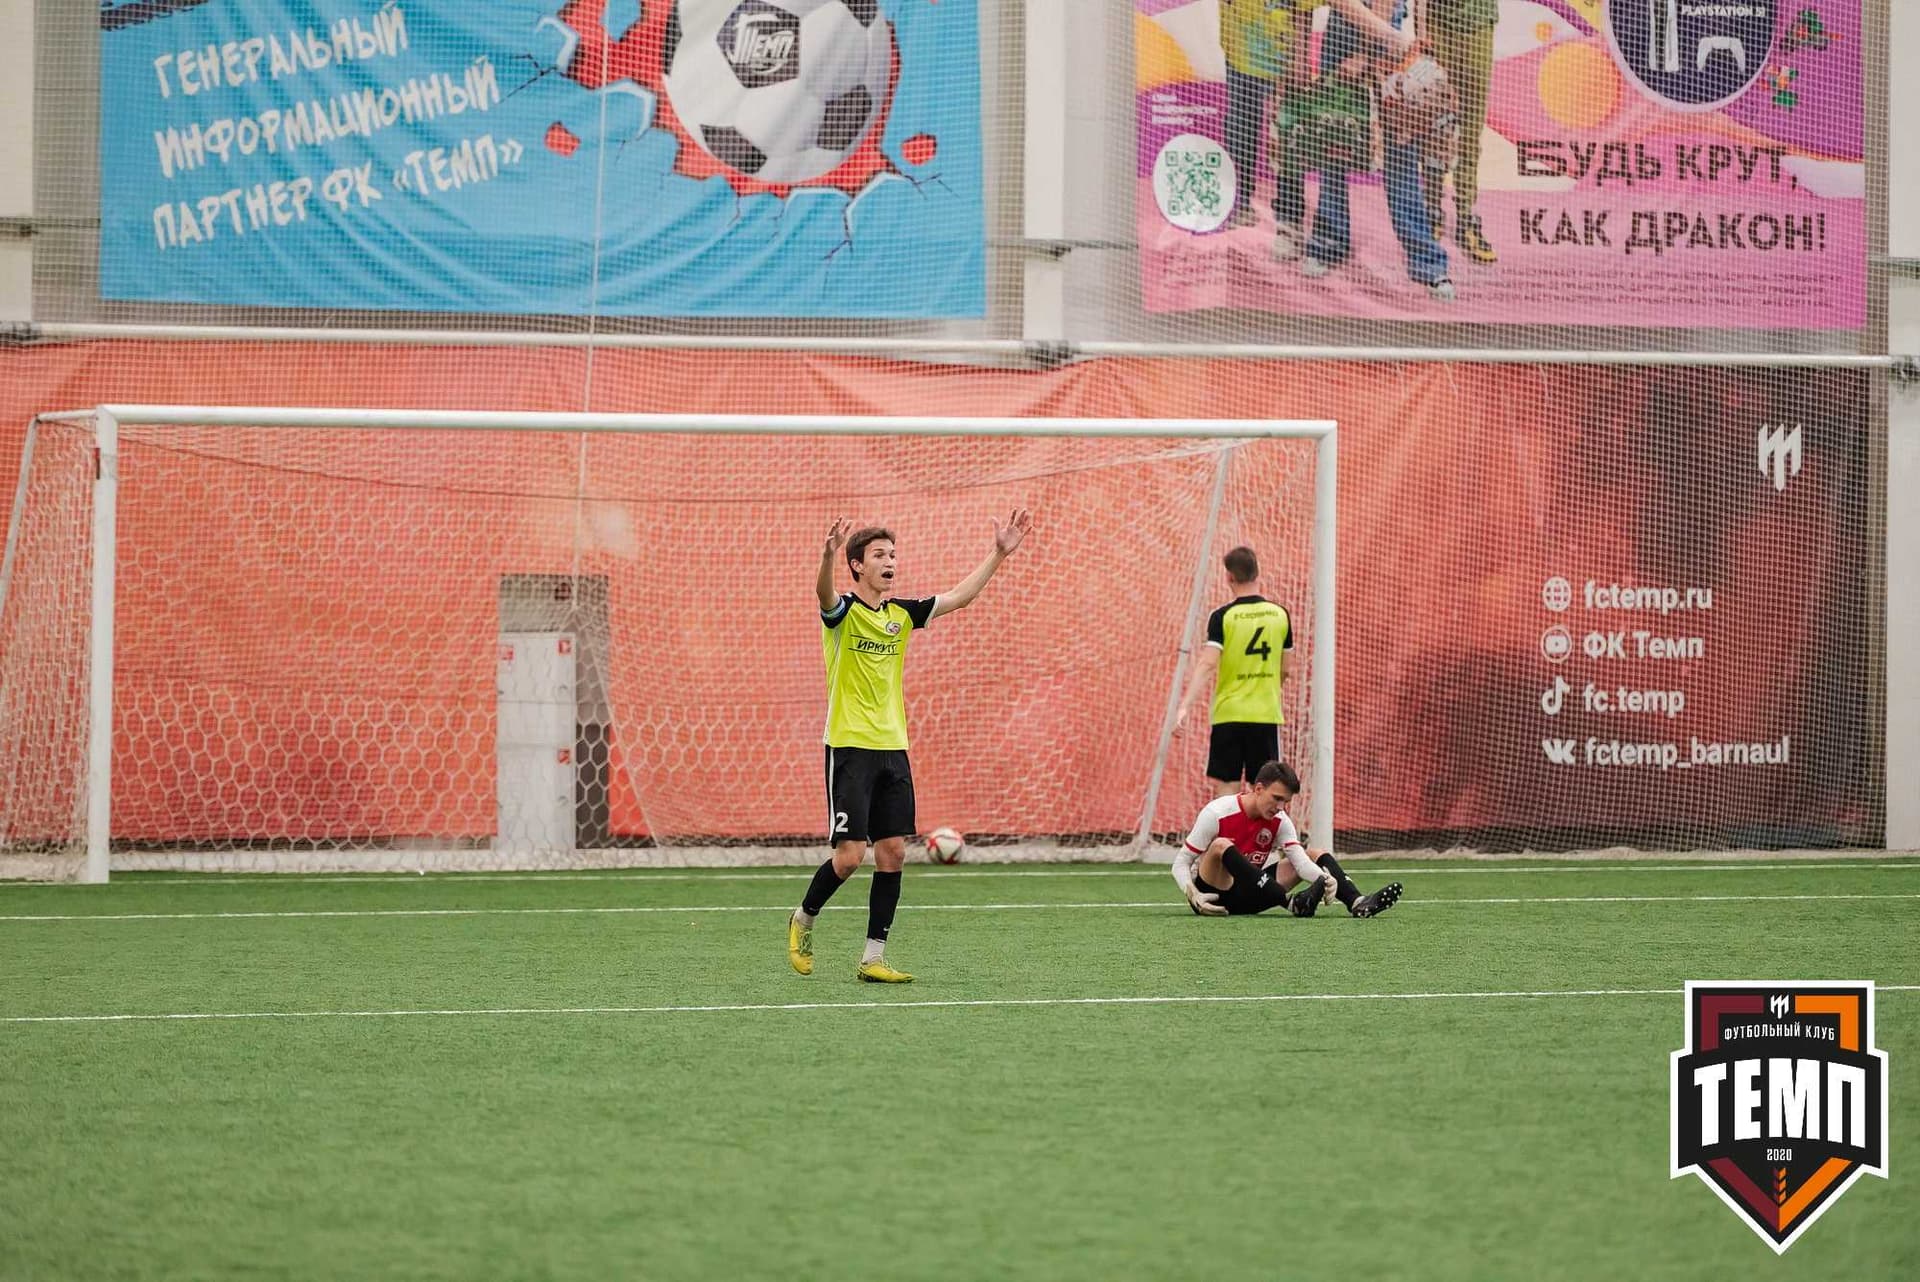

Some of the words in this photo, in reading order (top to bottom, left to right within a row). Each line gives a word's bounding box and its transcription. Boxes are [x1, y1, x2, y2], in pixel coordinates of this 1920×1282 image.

[1681, 4, 1752, 17] PLAYSTATION
[154, 2, 408, 98] ГЕНЕРАЛЬНЫЙ
[155, 56, 500, 179] ИНФОРМАЦИОННЫЙ
[1516, 140, 1661, 187] БУДЬ
[1676, 143, 1798, 190] КРУТ,
[154, 176, 312, 250] ПАРТНЕР
[321, 159, 382, 212] ФК
[393, 133, 524, 195] «ТЕМП»
[1519, 207, 1612, 248] КАК
[1624, 211, 1826, 256] ДРАКОН!
[1584, 579, 1713, 616] fctemp.ru
[1244, 626, 1271, 661] 4
[1583, 631, 1627, 659] ФК
[1634, 631, 1705, 659] Темп
[1583, 684, 1686, 718] fc.temp
[1584, 736, 1790, 770] fctemp_barnaul
[835, 812, 849, 832] 2
